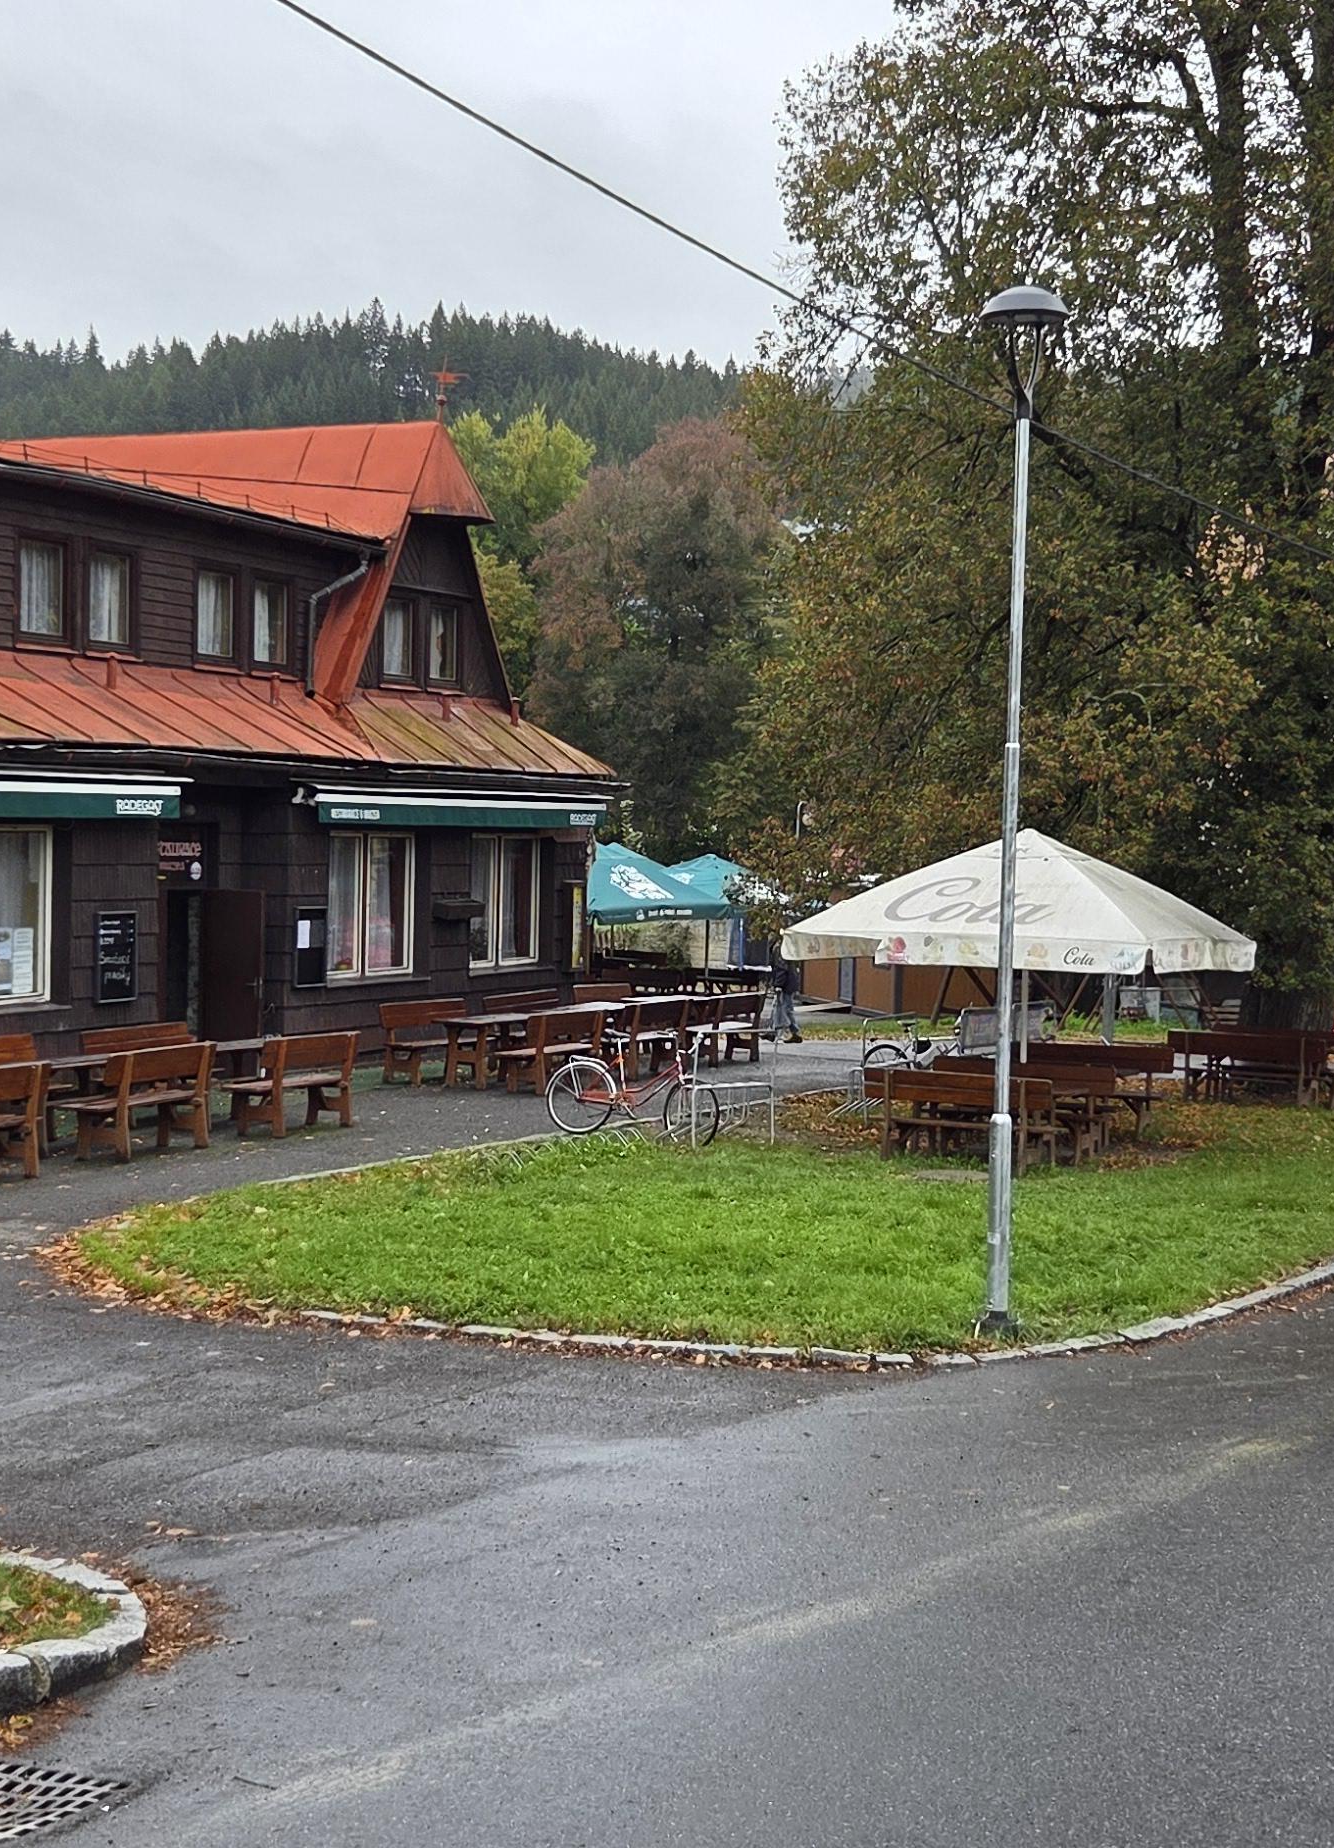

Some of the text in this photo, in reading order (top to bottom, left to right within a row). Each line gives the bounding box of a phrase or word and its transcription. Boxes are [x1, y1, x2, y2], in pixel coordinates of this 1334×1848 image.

[116, 799, 164, 816] RADEGAST
[884, 876, 1056, 924] Cola
[1063, 946, 1096, 967] Cola
